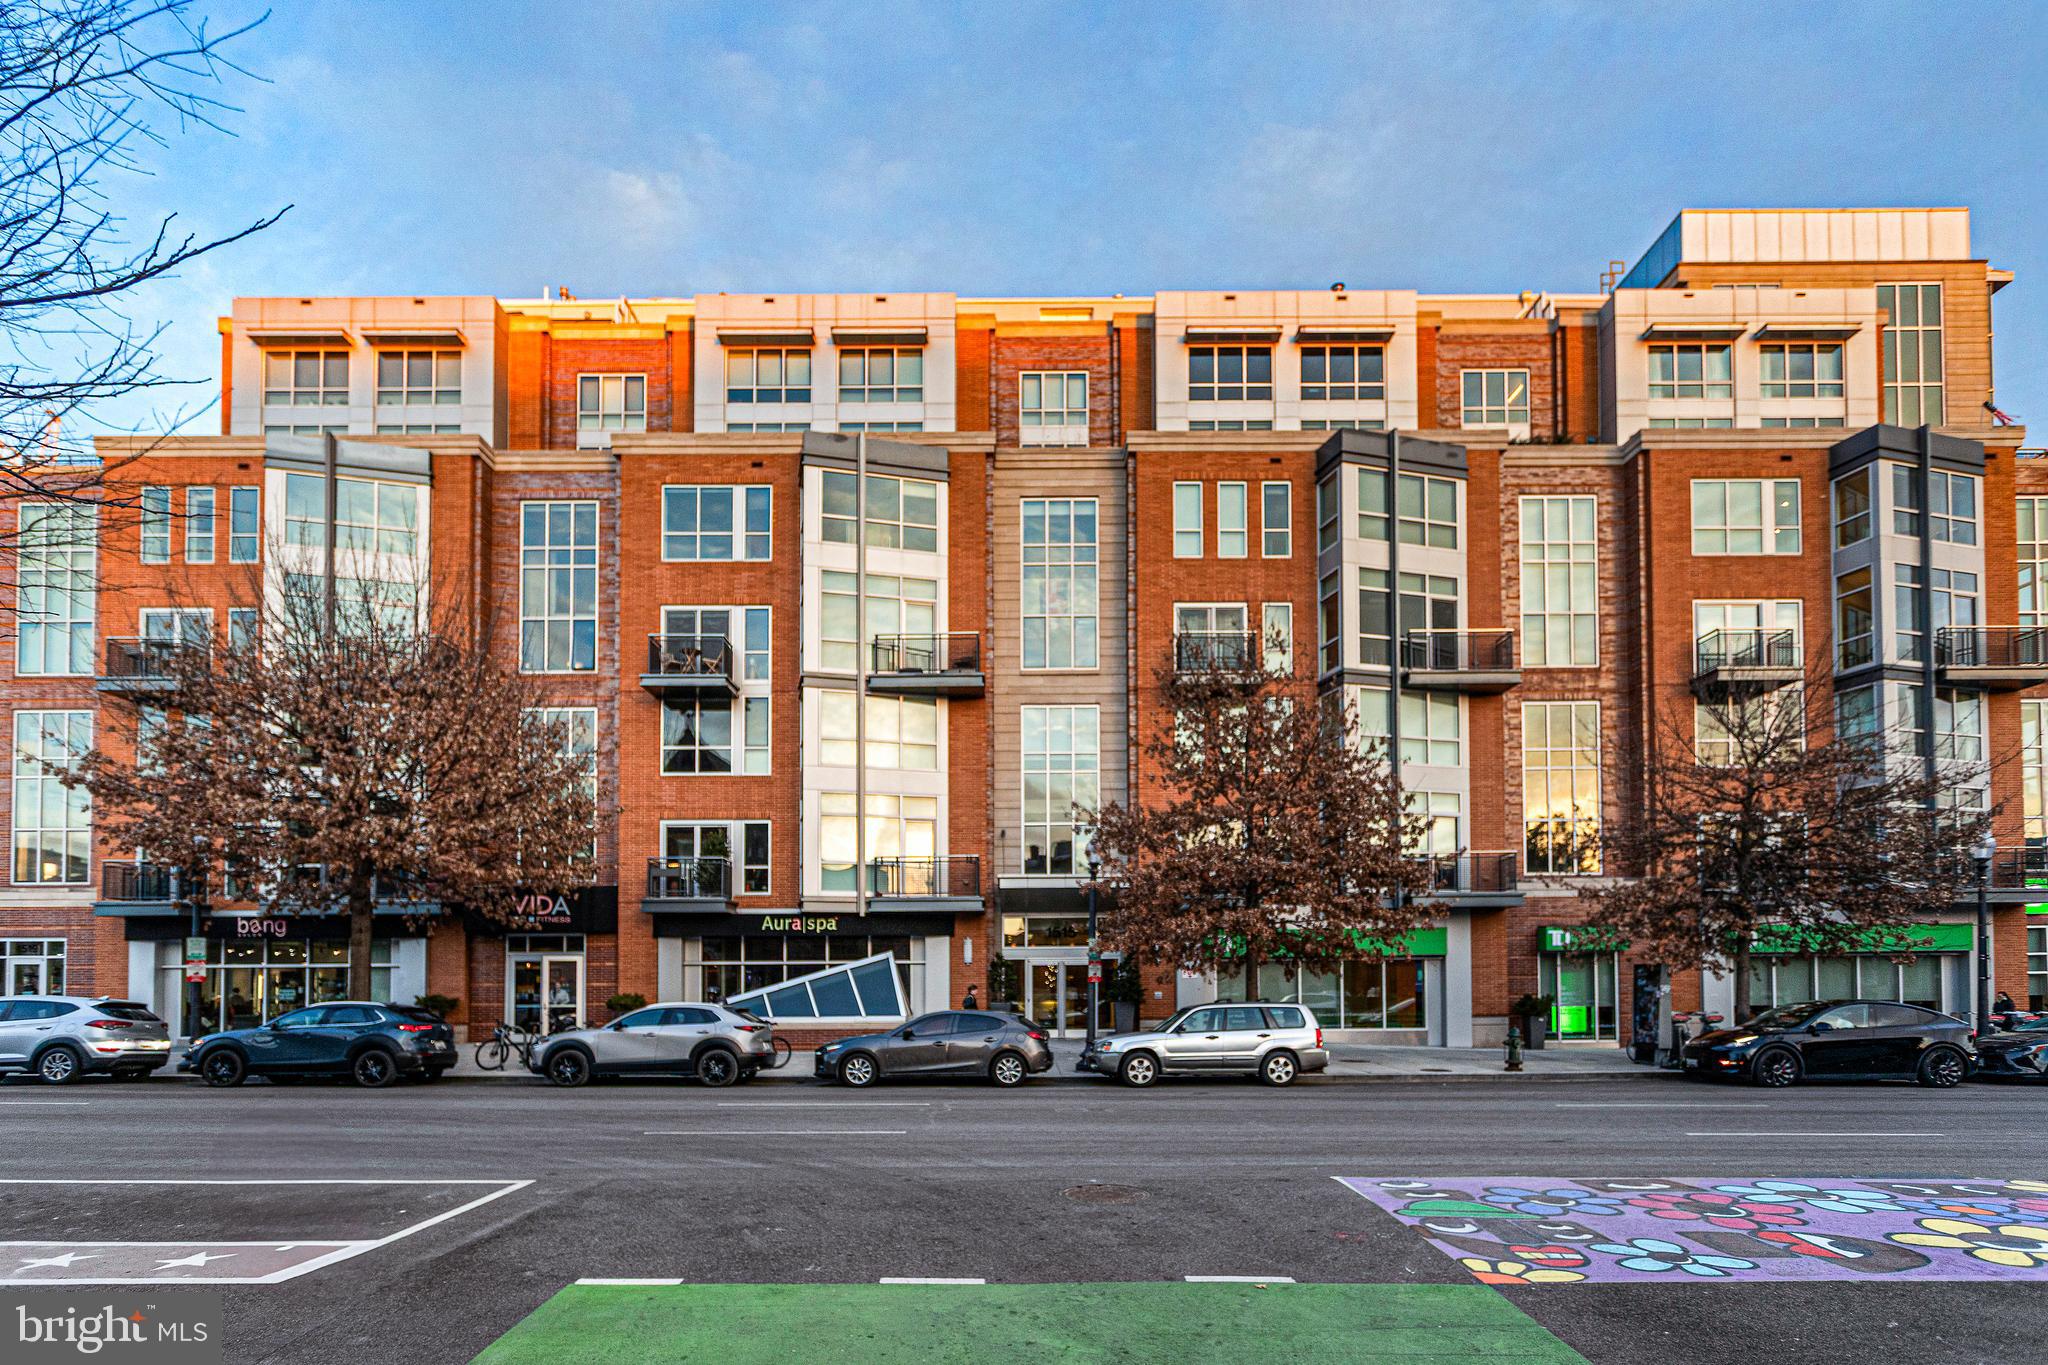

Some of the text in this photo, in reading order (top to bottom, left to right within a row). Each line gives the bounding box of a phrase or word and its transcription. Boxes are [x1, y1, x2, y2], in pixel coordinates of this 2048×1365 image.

[511, 894, 571, 915] VIDA
[237, 917, 287, 938] bang
[1546, 930, 1571, 946] TD
